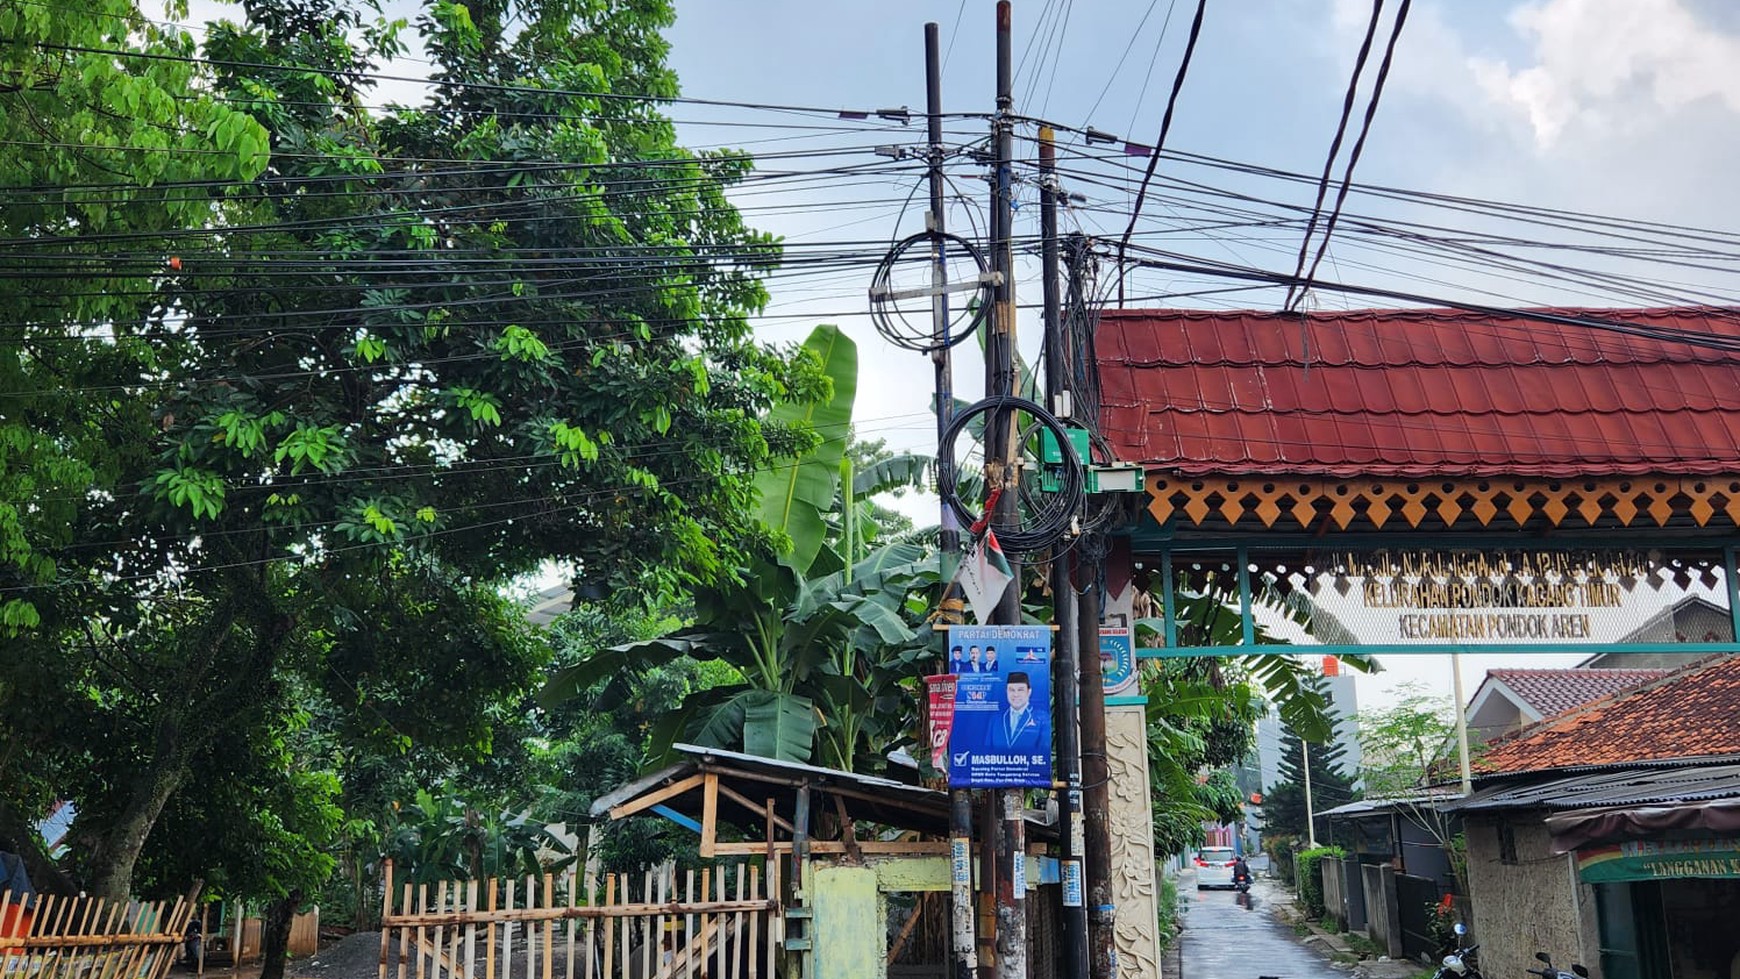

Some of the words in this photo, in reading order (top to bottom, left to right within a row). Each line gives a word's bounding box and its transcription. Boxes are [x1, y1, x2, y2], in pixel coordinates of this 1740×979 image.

[1363, 582, 1449, 608] KELURAHAN
[1452, 582, 1513, 608] PONDOK
[1515, 582, 1574, 608] KACANG
[1578, 582, 1623, 608] TIMUR
[958, 630, 989, 640] PARTAI
[992, 629, 1040, 639] DEMOKRAT
[1400, 613, 1486, 639] KECAMATAN
[1488, 613, 1549, 639] PONDOK
[1551, 613, 1591, 639] AREN
[971, 755, 1030, 766] MASBULLOH,
[1031, 755, 1047, 765] SE.
